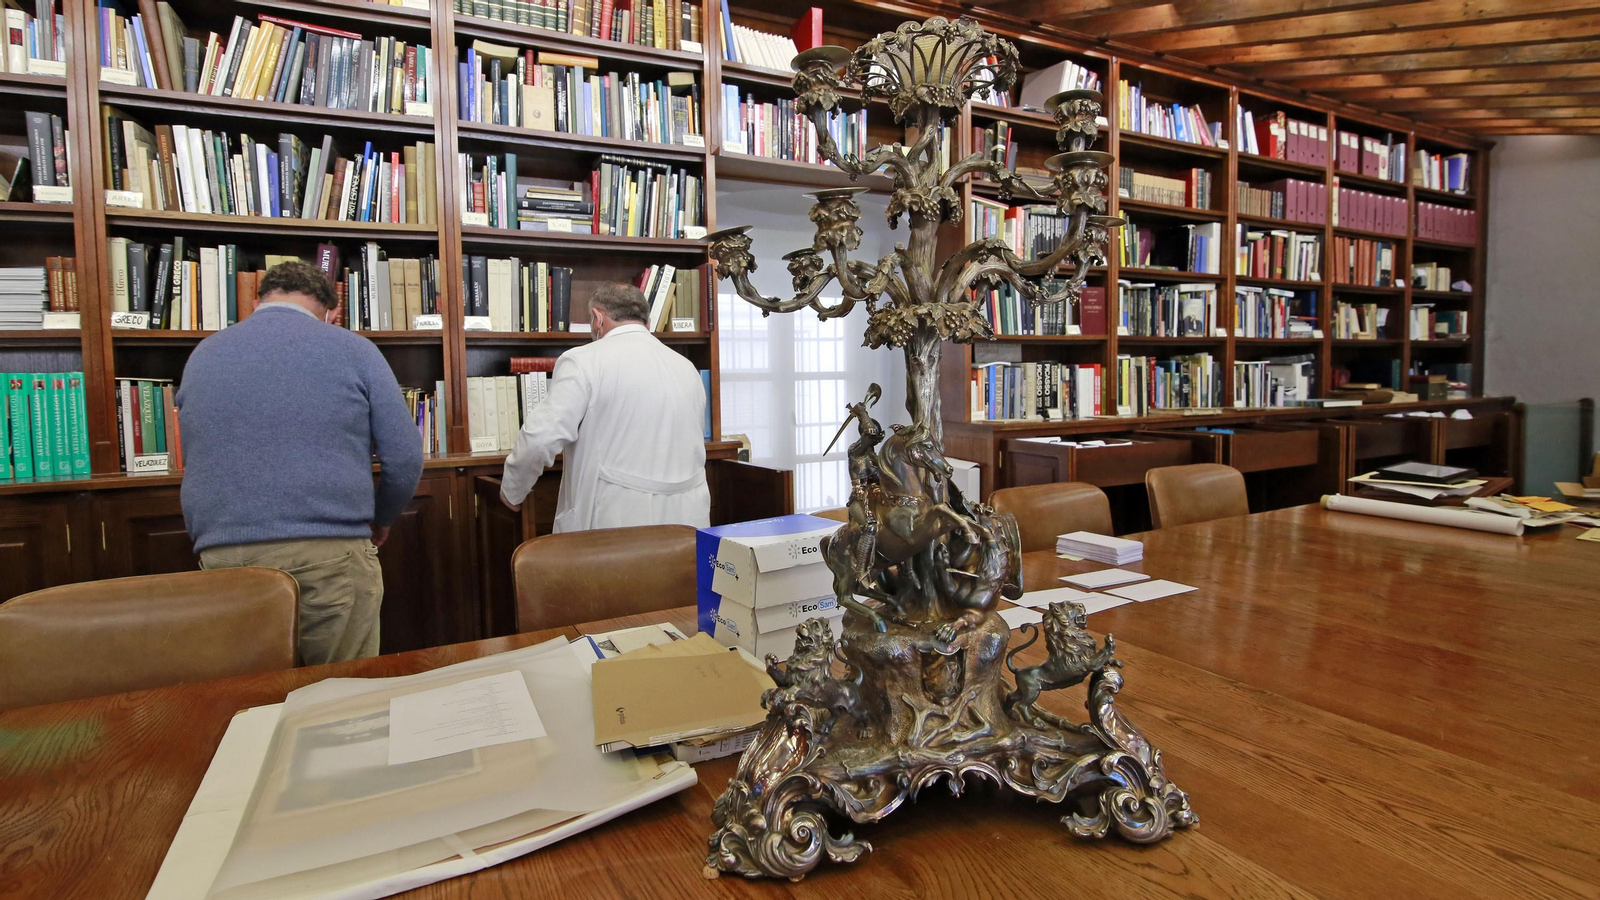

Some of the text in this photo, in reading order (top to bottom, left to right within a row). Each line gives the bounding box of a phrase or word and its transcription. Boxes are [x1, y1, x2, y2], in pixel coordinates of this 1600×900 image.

[116, 269, 125, 288] Greco
[173, 260, 181, 294] EL GRECO
[660, 268, 672, 294] RIBERA
[115, 315, 143, 324] GRECO
[53, 394, 61, 426] GALLEGOS
[69, 392, 77, 424] GALLEGOS
[143, 385, 152, 424] VELÁZQUEZ
[10, 394, 21, 457] ARTISTAS GALLEGOS
[36, 428, 44, 456] ARTISTAS
[135, 458, 167, 467] VELAZQUEZ
[802, 546, 818, 555] Eco
[716, 560, 735, 573] Eco Sam
[802, 600, 834, 612] Eco Sam
[717, 615, 736, 630] Eco Sam
